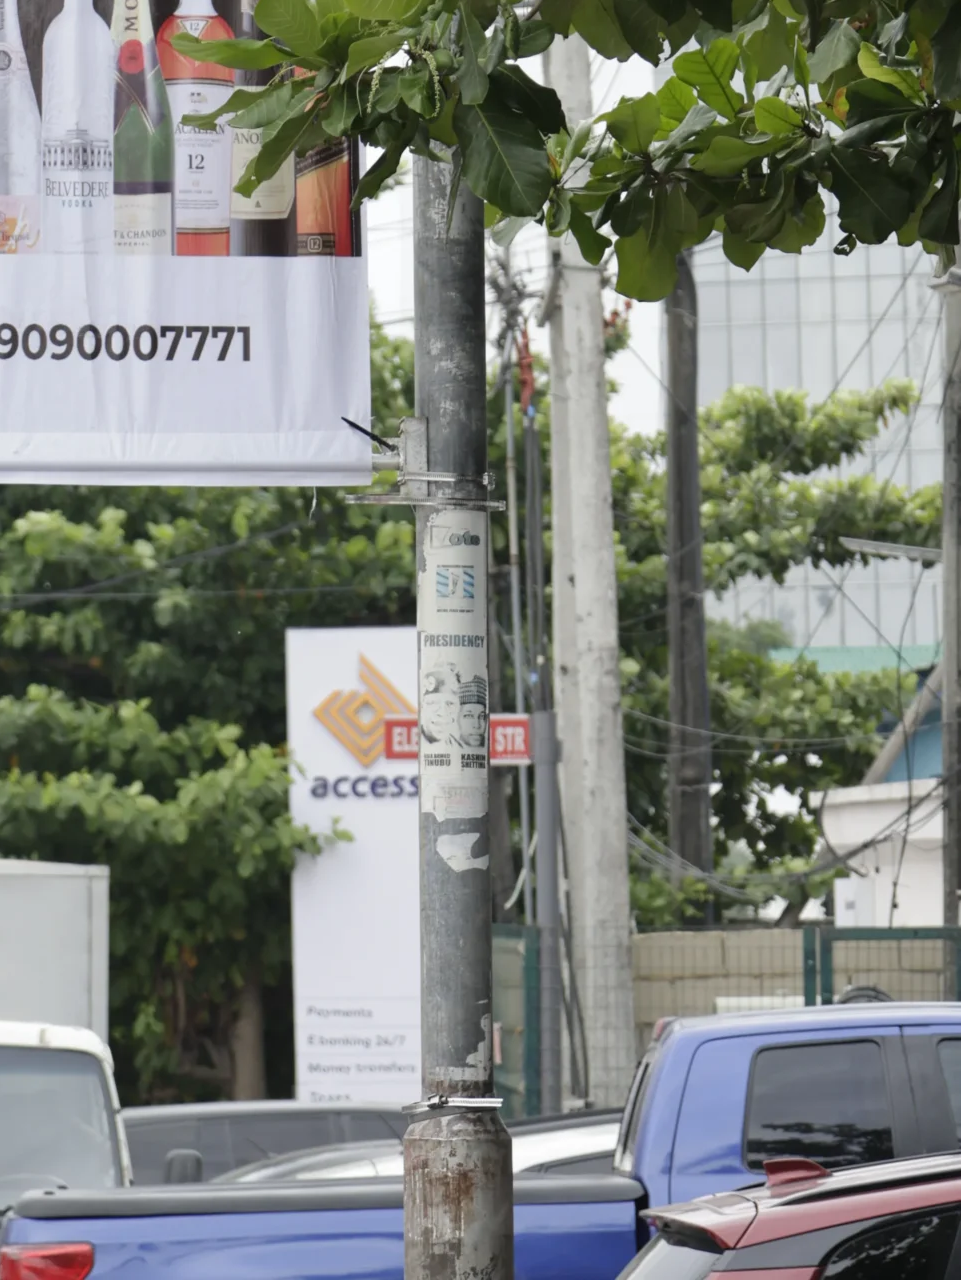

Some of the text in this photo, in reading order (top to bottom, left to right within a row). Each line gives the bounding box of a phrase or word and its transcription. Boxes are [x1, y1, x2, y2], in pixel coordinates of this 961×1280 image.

[190, 22, 200, 31] 12
[188, 153, 205, 170] 12
[45, 178, 109, 198] BELVEDERE
[61, 199, 93, 208] VODKA
[309, 236, 320, 249] 12
[423, 634, 485, 648] PRESIDENCY
[494, 726, 526, 753] STR
[310, 775, 419, 799] access
[306, 1005, 374, 1019] Payments
[319, 1034, 372, 1049] banking
[375, 1033, 407, 1047] 24/7
[307, 1062, 417, 1076] Money transfers
